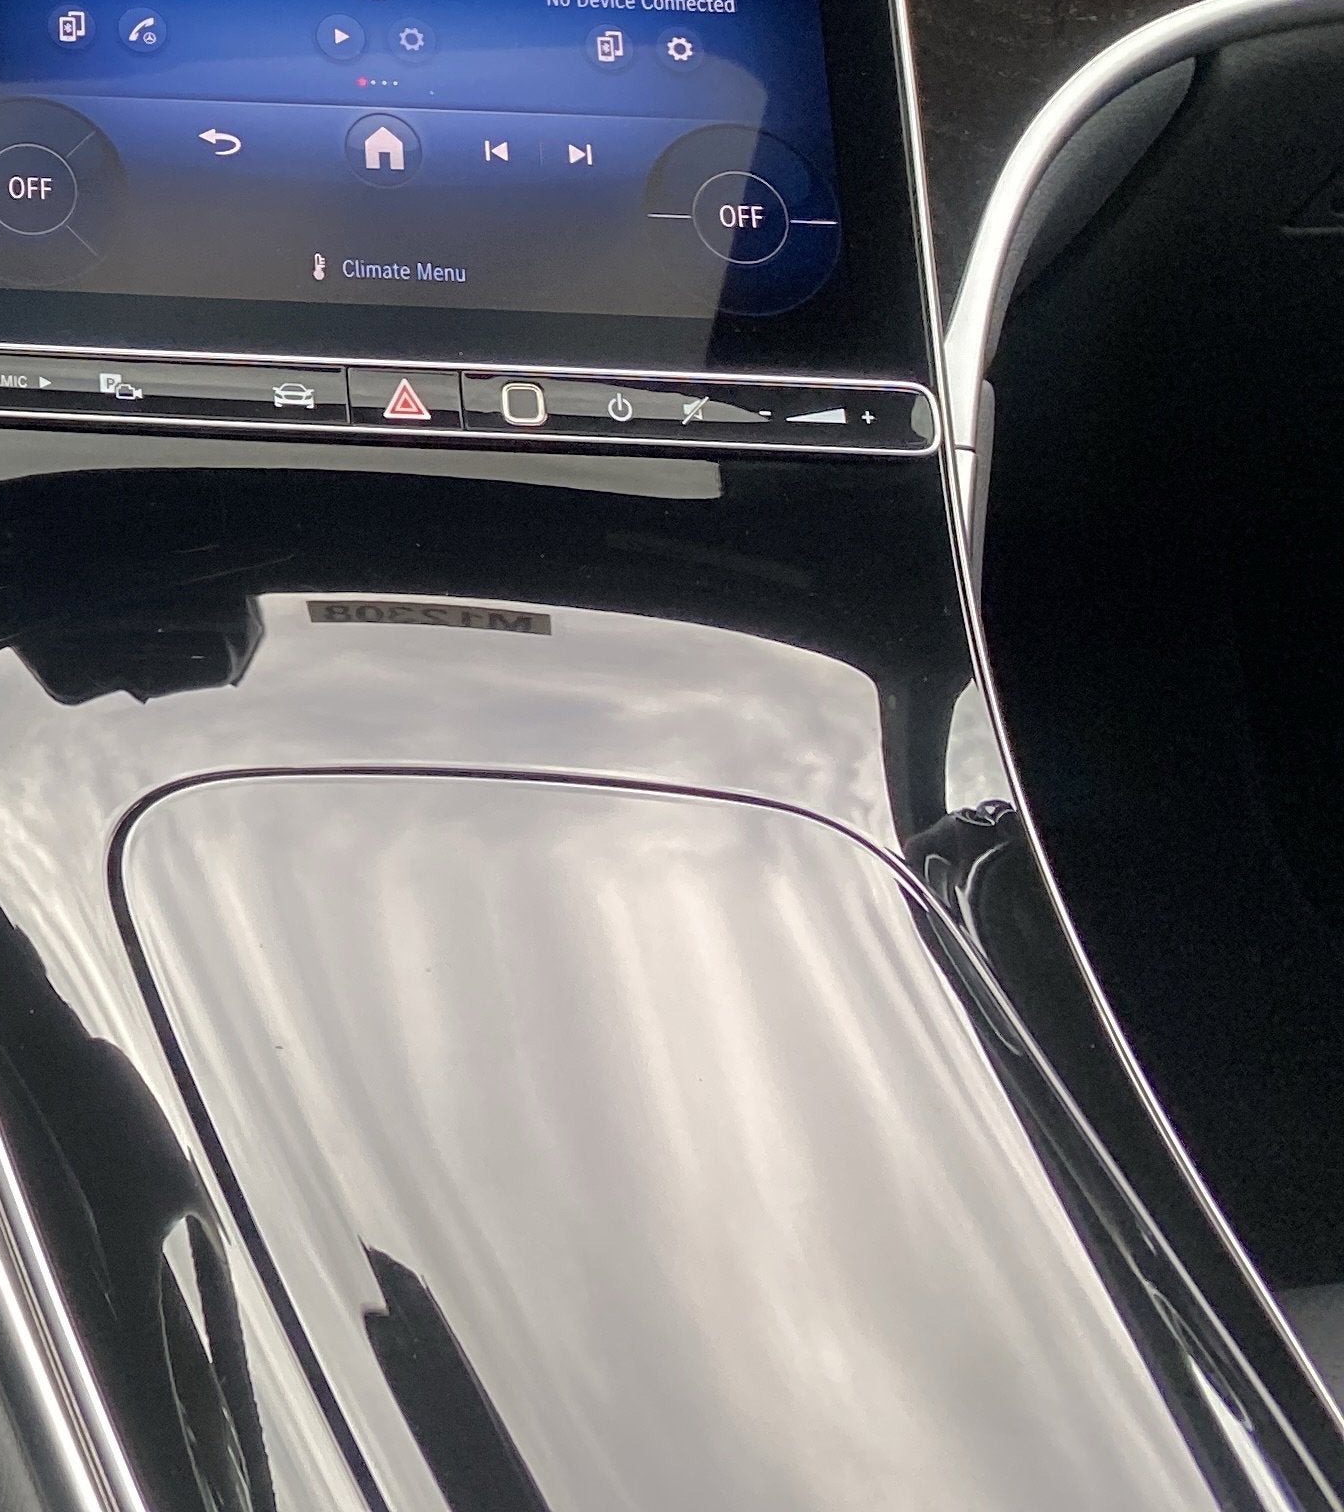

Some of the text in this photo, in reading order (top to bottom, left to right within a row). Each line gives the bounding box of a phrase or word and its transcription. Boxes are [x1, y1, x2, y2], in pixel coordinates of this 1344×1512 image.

[8, 176, 52, 200] OFF
[719, 204, 764, 229] OFF
[342, 259, 466, 282] Climate Menu
